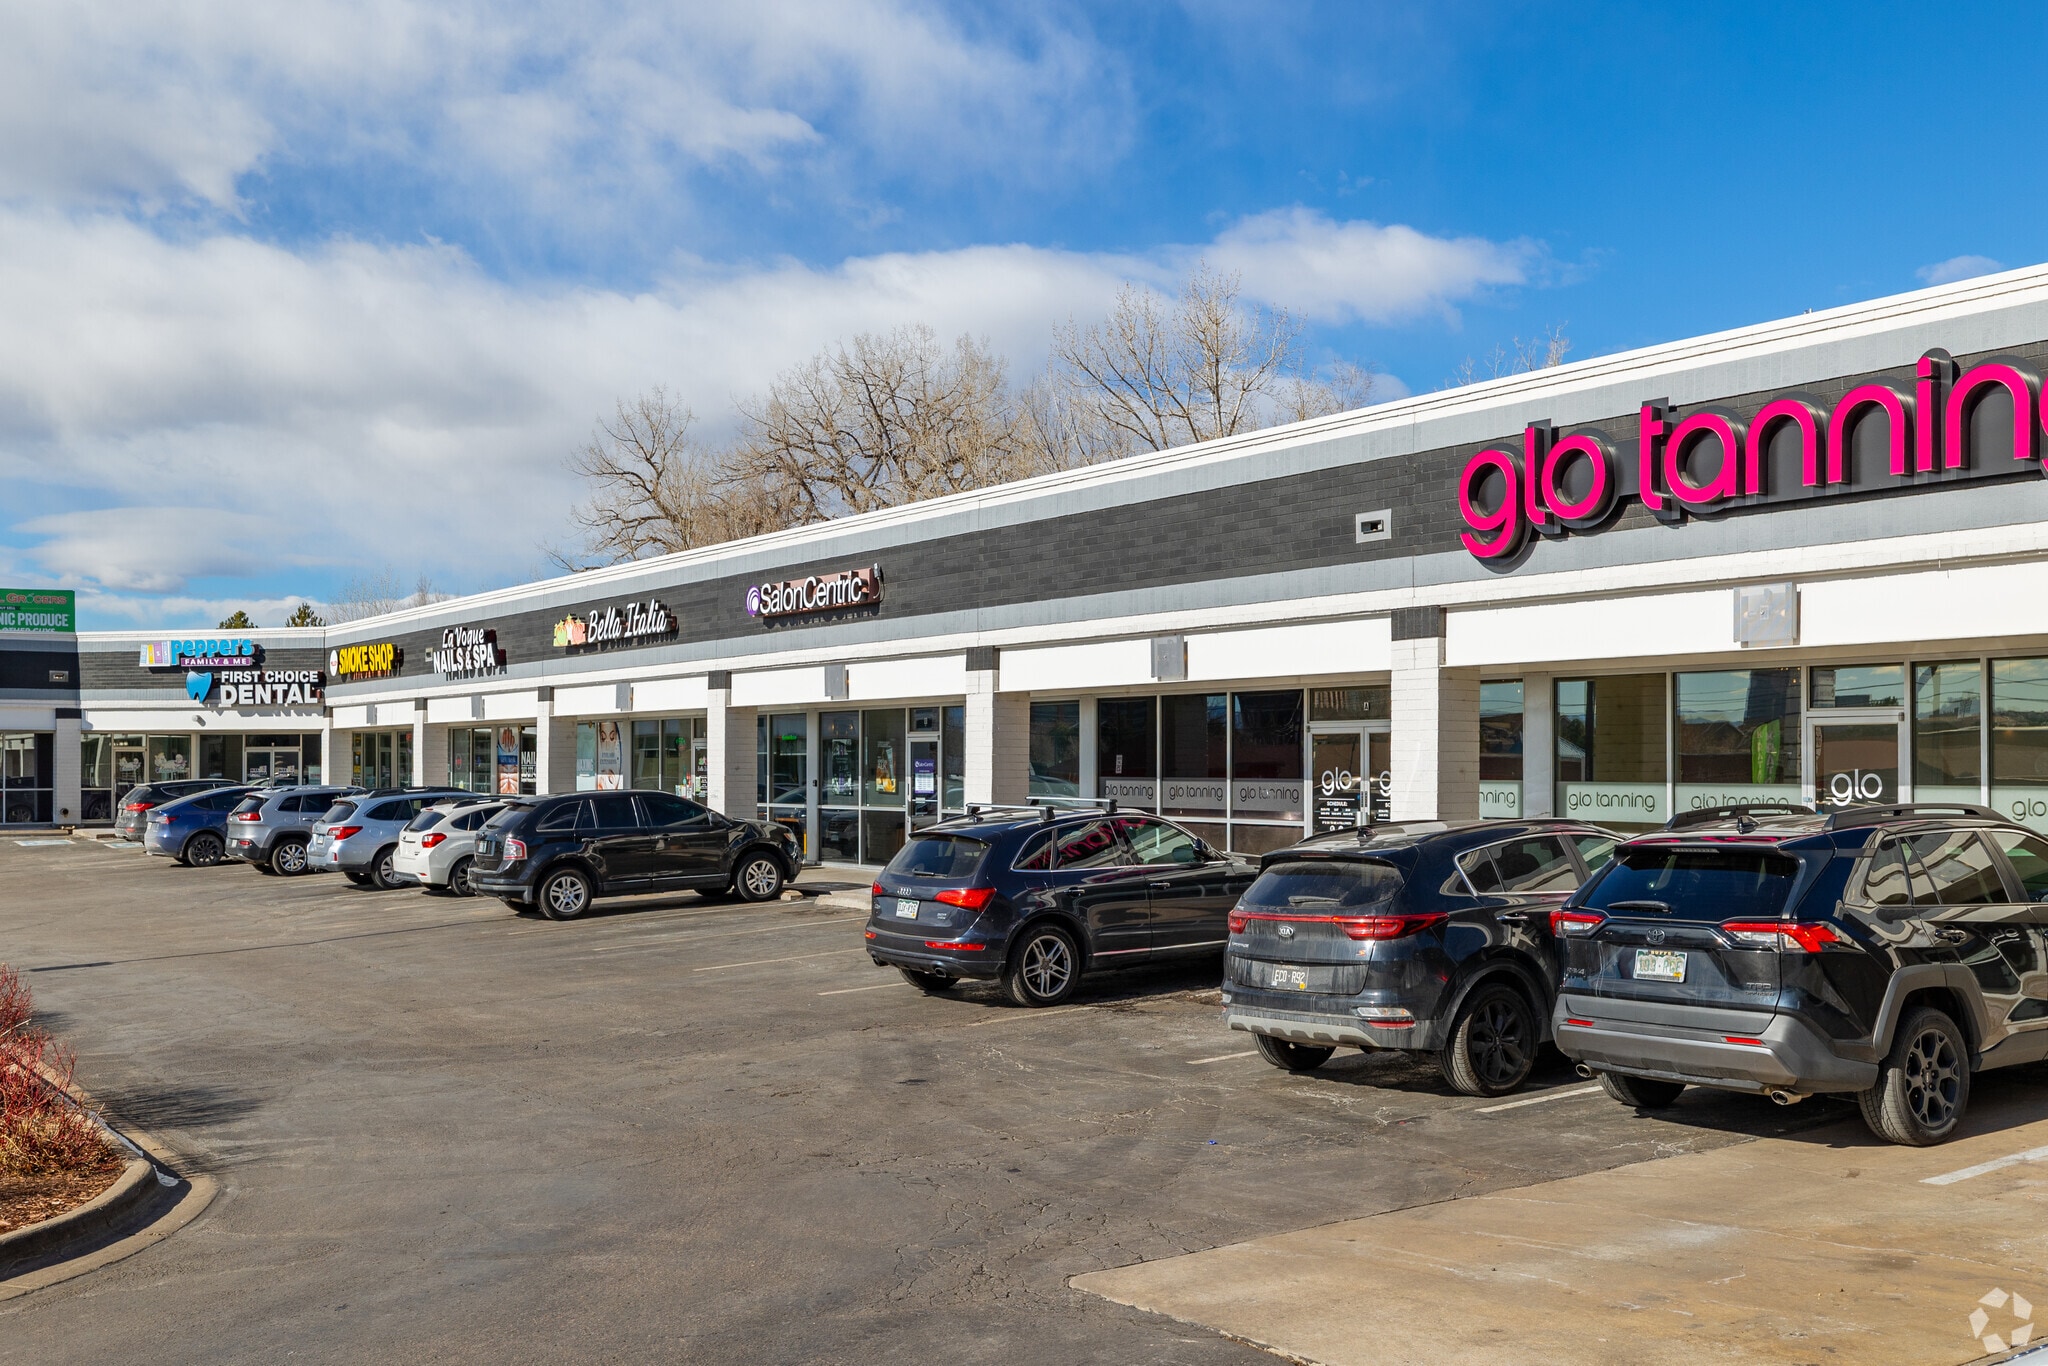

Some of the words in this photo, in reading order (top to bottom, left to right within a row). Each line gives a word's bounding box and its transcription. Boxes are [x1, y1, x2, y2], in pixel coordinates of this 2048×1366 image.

[1459, 426, 1607, 558] glo
[760, 570, 862, 615] SalonCentric
[18, 613, 69, 627] PRODUCE
[588, 606, 622, 643] Bella
[625, 598, 667, 638] Italia
[455, 627, 485, 648] Vogue
[171, 638, 253, 665] pepper's
[338, 646, 368, 675] SMOKE
[368, 643, 394, 672] SHOP
[433, 648, 464, 674] NAILS
[465, 649, 472, 670] &
[473, 643, 496, 670] SPA
[221, 671, 261, 683] FIRST
[264, 671, 318, 683] CHOICE
[219, 684, 318, 705] DENTAL
[1120, 785, 1154, 800] tanning
[1321, 767, 1352, 796] glo
[1831, 769, 1883, 806] glo
[1169, 785, 1185, 800] glo
[1186, 785, 1224, 801] tanning
[1240, 786, 1256, 802] glo
[1258, 786, 1299, 803] tanning
[1568, 792, 1592, 810] glo
[1596, 792, 1655, 812] tanning
[2012, 798, 2047, 821] glo
[1279, 927, 1293, 936] KIA
